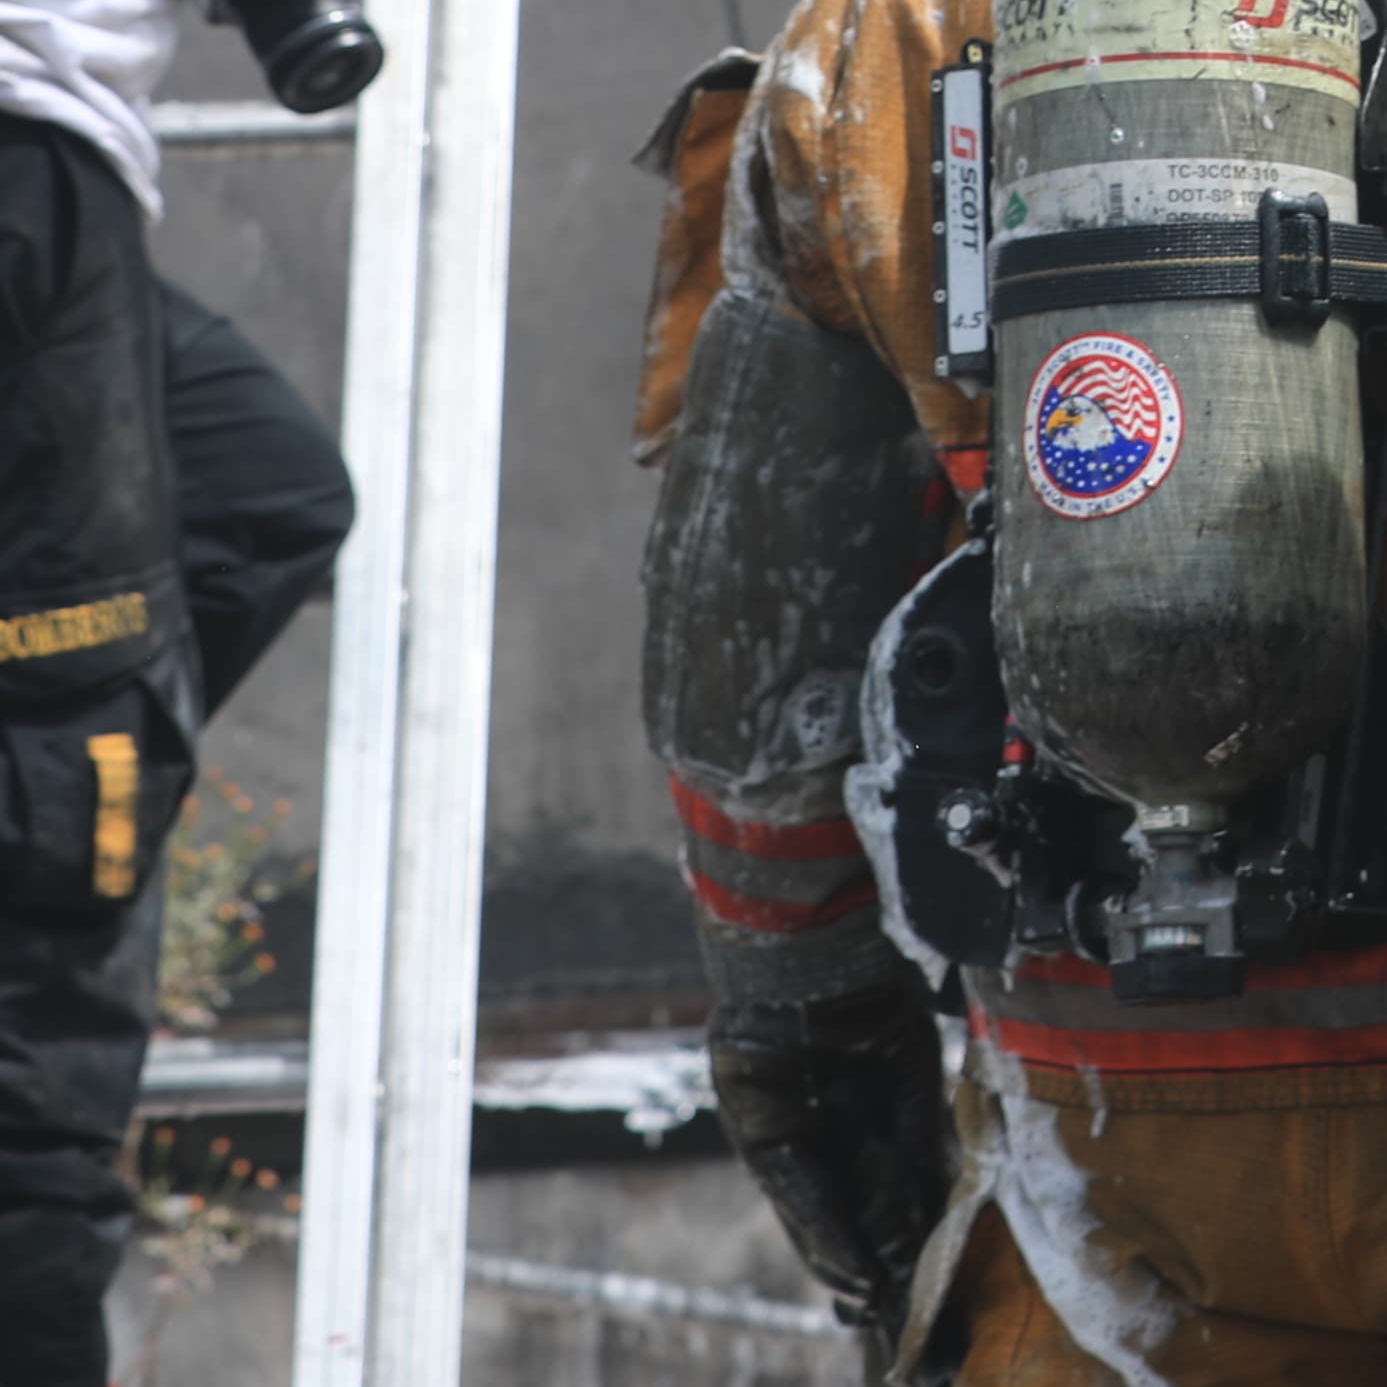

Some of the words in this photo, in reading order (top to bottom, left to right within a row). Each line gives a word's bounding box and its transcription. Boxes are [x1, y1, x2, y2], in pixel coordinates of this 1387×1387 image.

[1167, 188, 1234, 203] DOT-SP
[960, 166, 979, 254] SCOTT
[951, 311, 982, 330] 4.5
